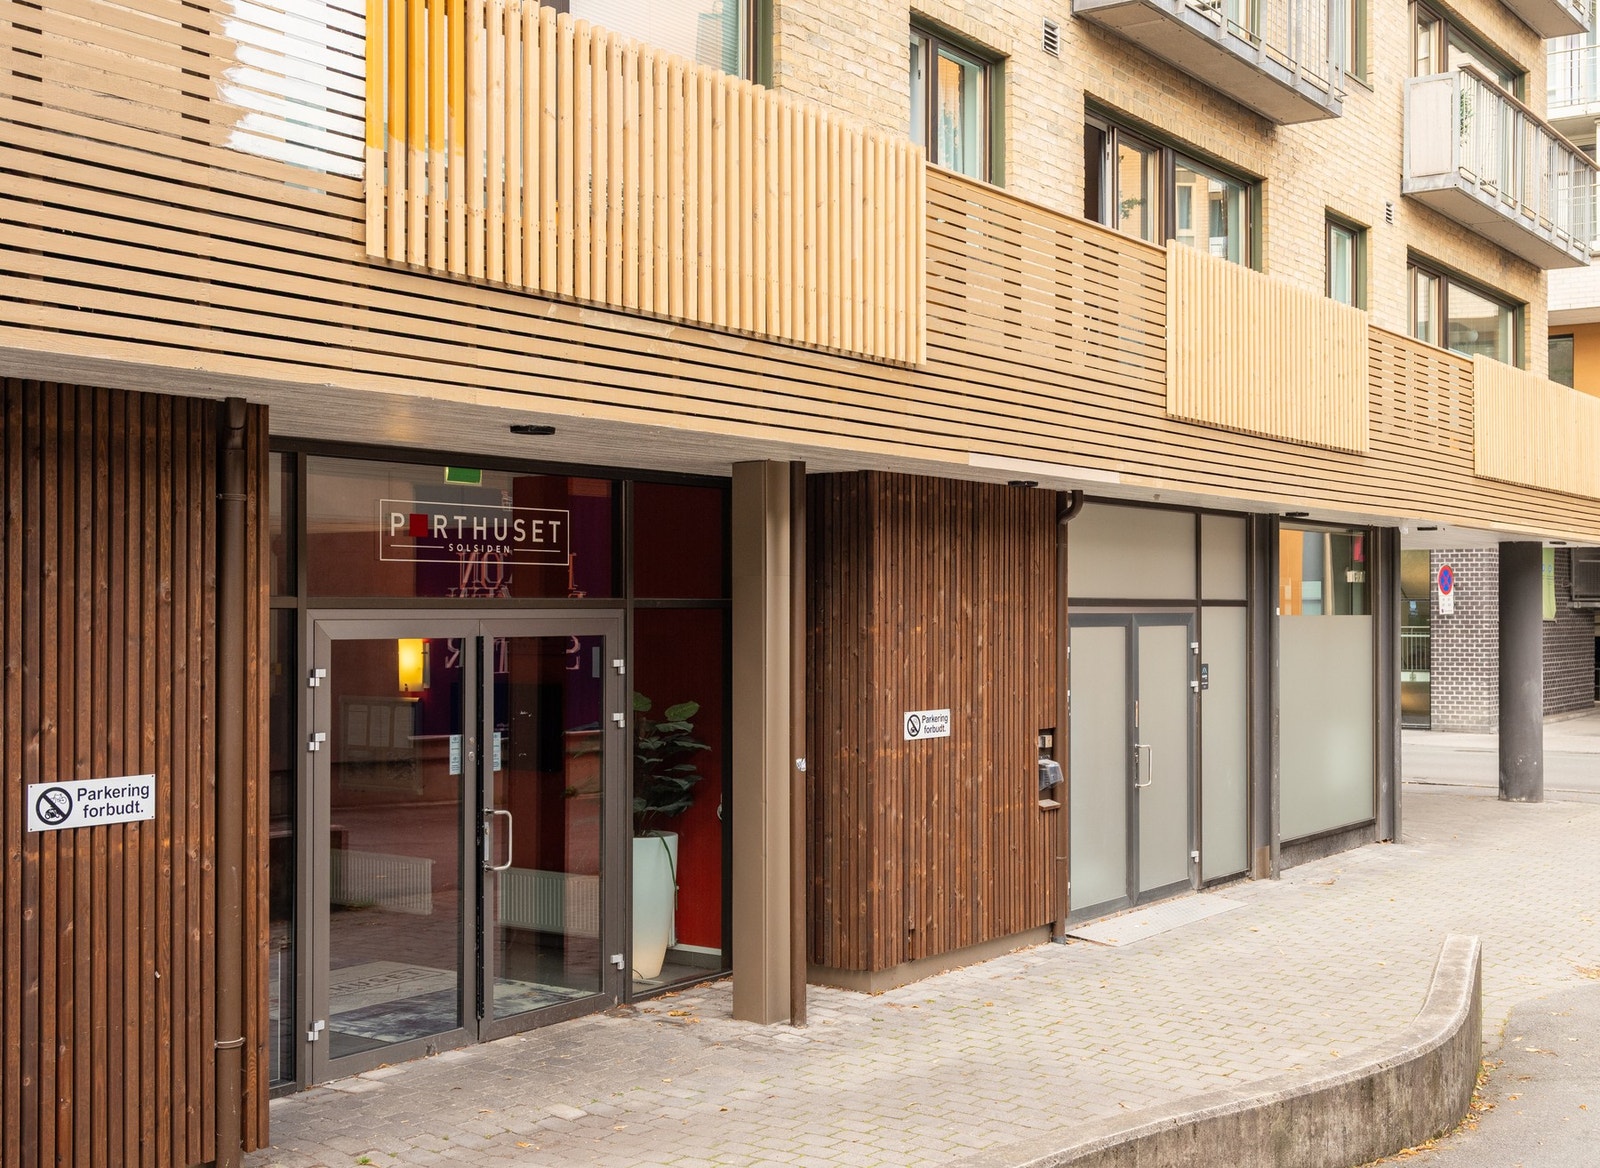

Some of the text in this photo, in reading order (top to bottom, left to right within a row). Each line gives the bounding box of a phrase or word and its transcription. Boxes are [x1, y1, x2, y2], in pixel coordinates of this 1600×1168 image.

[390, 512, 562, 543] PRTHUSET
[448, 543, 511, 554] SOLSIDEN
[921, 714, 949, 724] Parkering
[77, 784, 150, 802] Parkering
[83, 801, 144, 818] forbudt.
